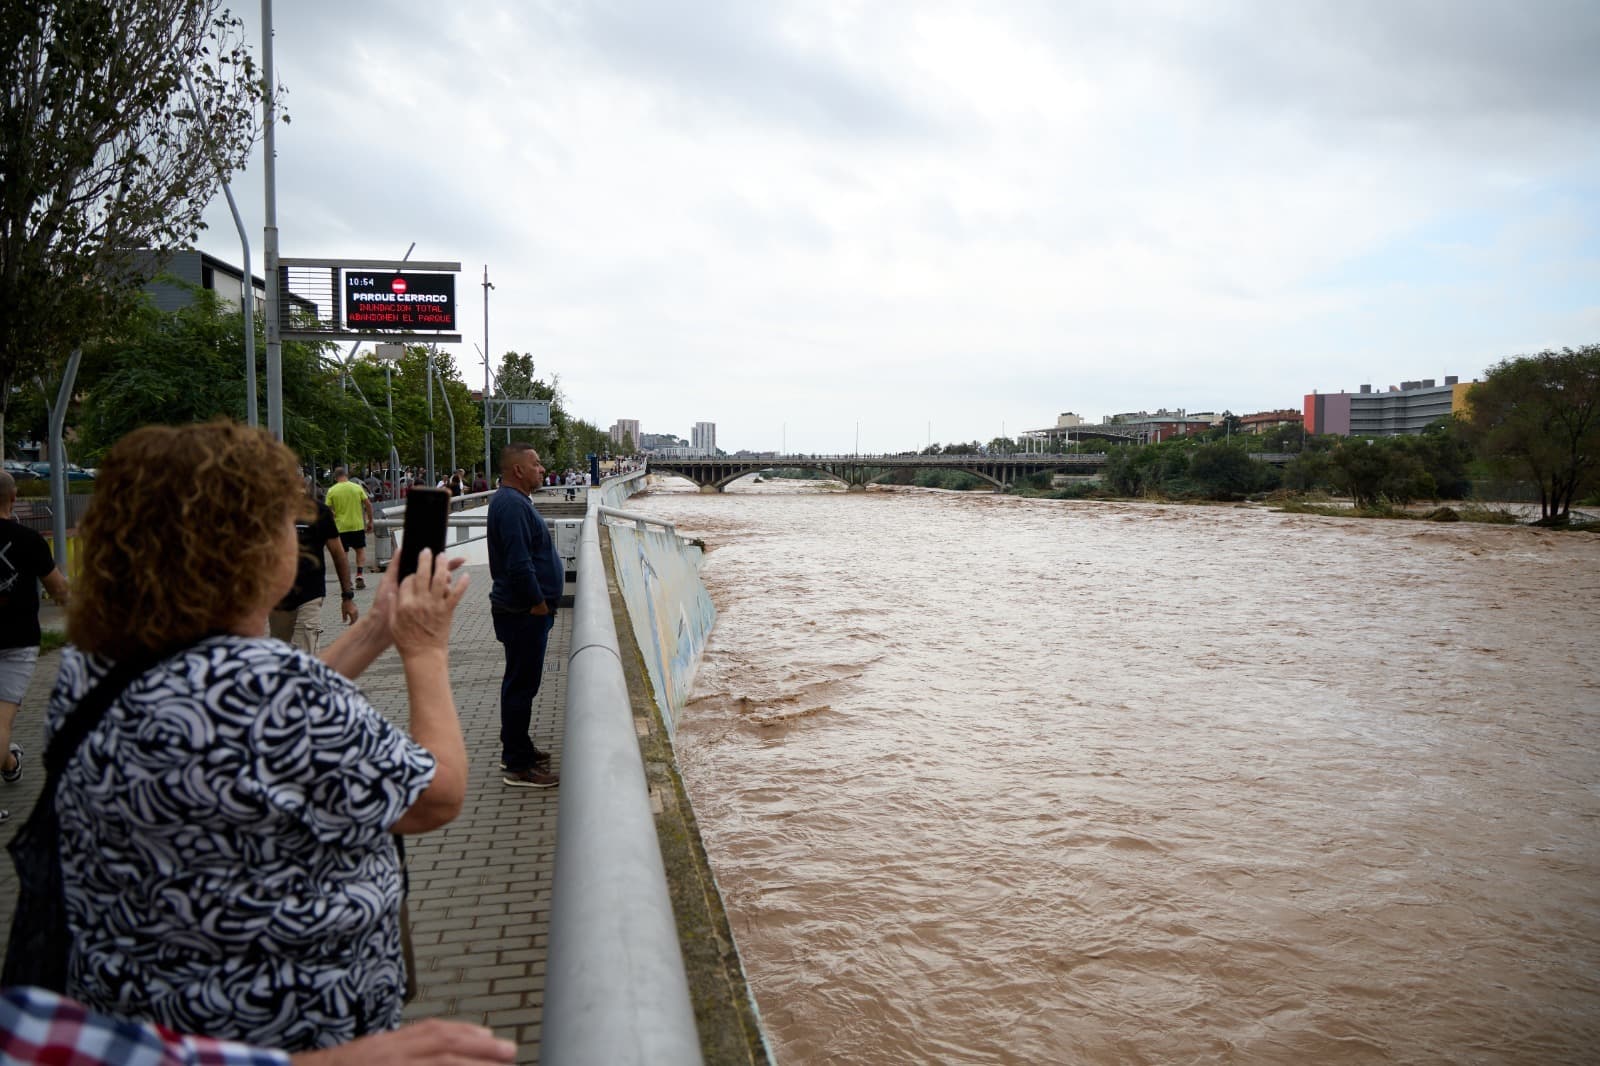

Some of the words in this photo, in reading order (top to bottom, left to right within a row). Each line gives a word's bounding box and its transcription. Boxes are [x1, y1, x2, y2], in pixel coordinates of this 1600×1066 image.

[349, 277, 375, 286] 10:54
[352, 293, 396, 302] PARQUE
[397, 294, 448, 302] CERRADO
[360, 304, 412, 312] INUNDACION
[416, 304, 442, 312] TOTAL
[402, 314, 414, 322] EL
[418, 314, 452, 323] PARQUE
